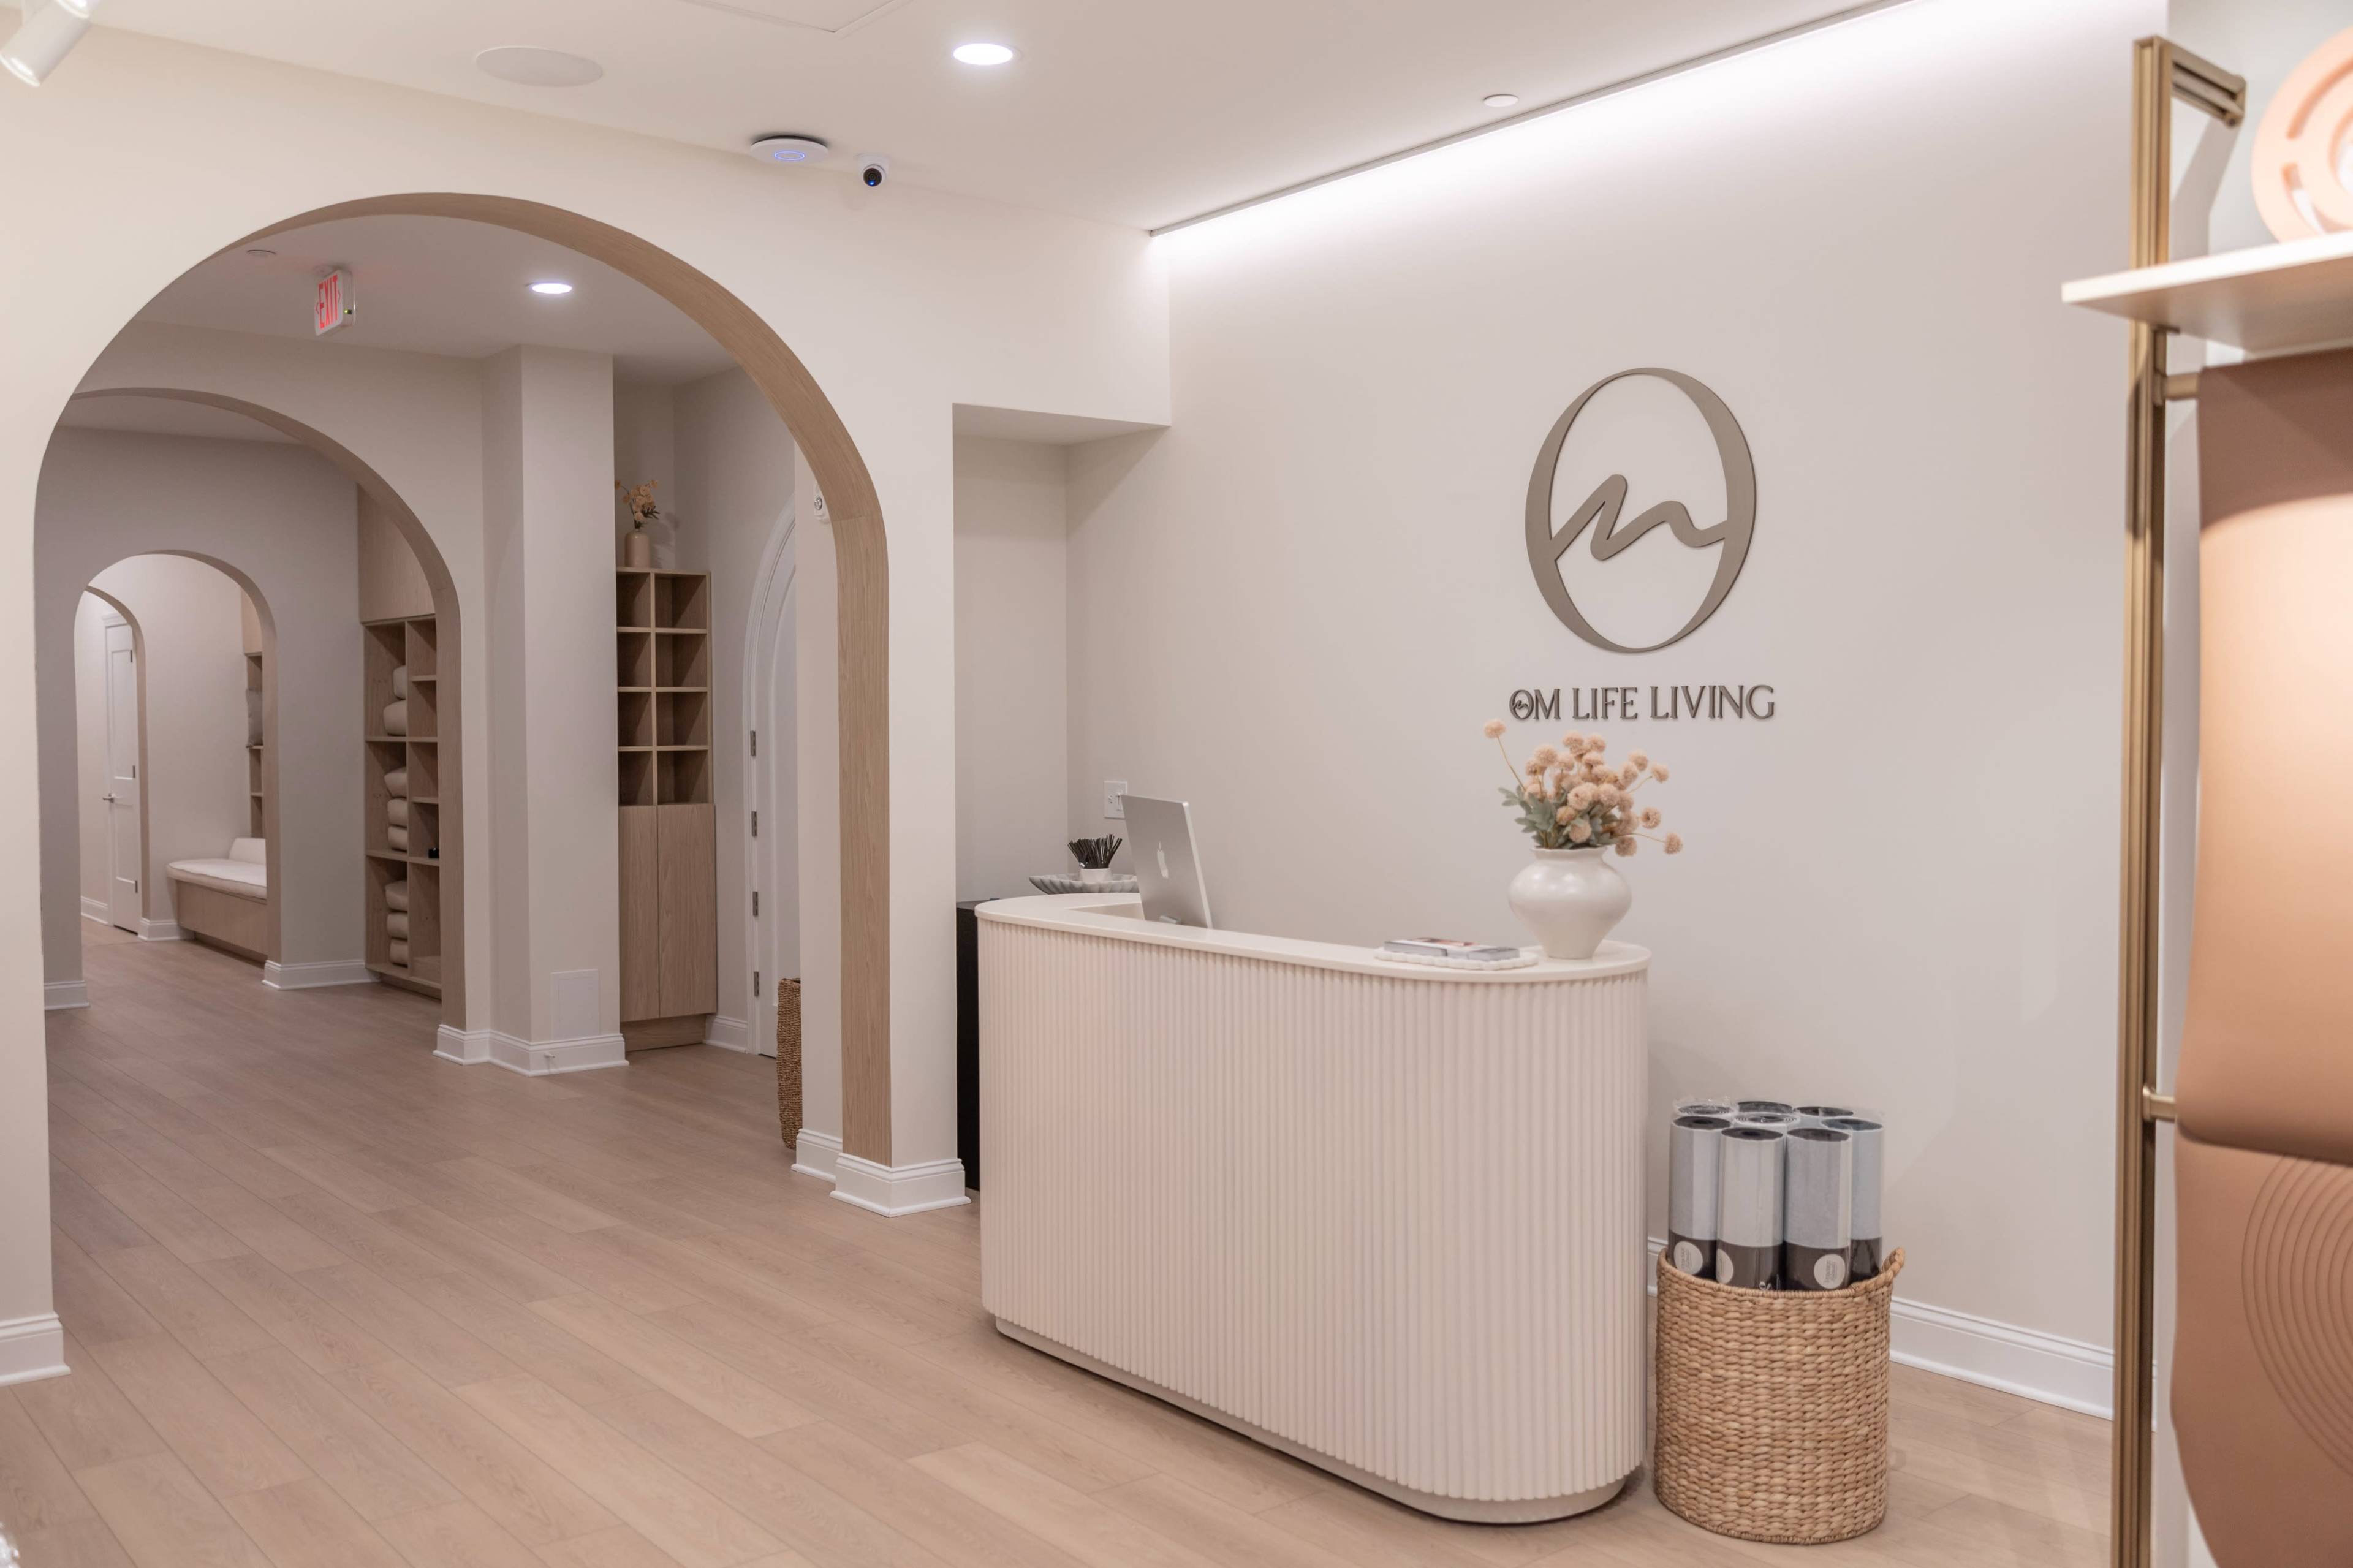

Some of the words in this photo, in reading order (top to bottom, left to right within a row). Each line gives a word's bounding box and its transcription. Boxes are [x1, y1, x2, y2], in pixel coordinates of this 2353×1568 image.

[318, 274, 338, 329] EXIT
[1509, 689, 1561, 720] OM
[1572, 687, 1639, 719] LIFE
[1650, 684, 1775, 719] LIVING
